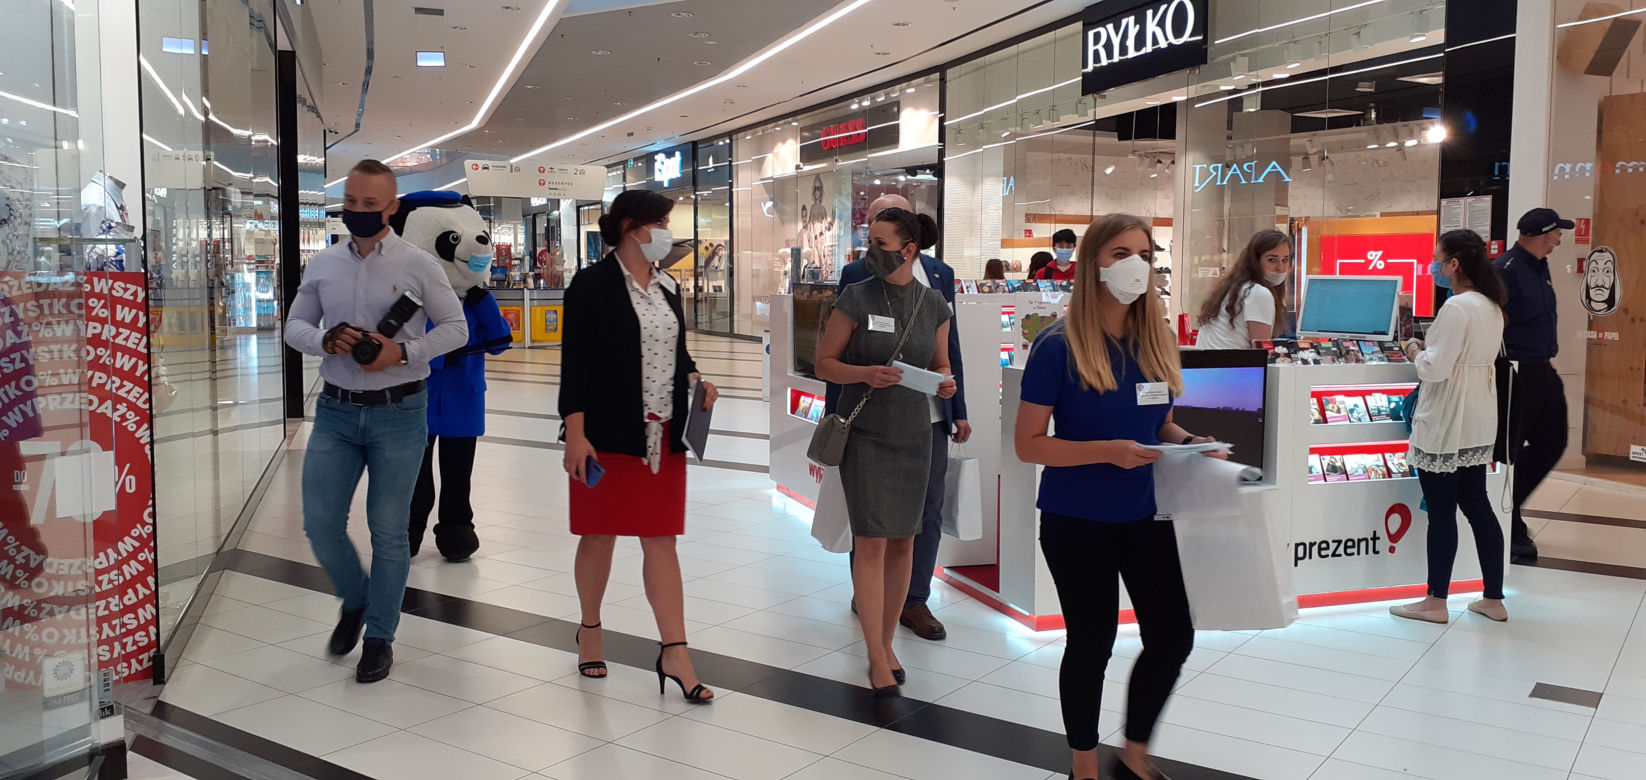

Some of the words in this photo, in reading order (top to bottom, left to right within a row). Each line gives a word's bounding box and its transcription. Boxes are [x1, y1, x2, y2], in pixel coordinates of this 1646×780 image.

[1086, 0, 1195, 72] RYŁKO
[1367, 250, 1385, 271] %
[1294, 530, 1381, 567] prezent
